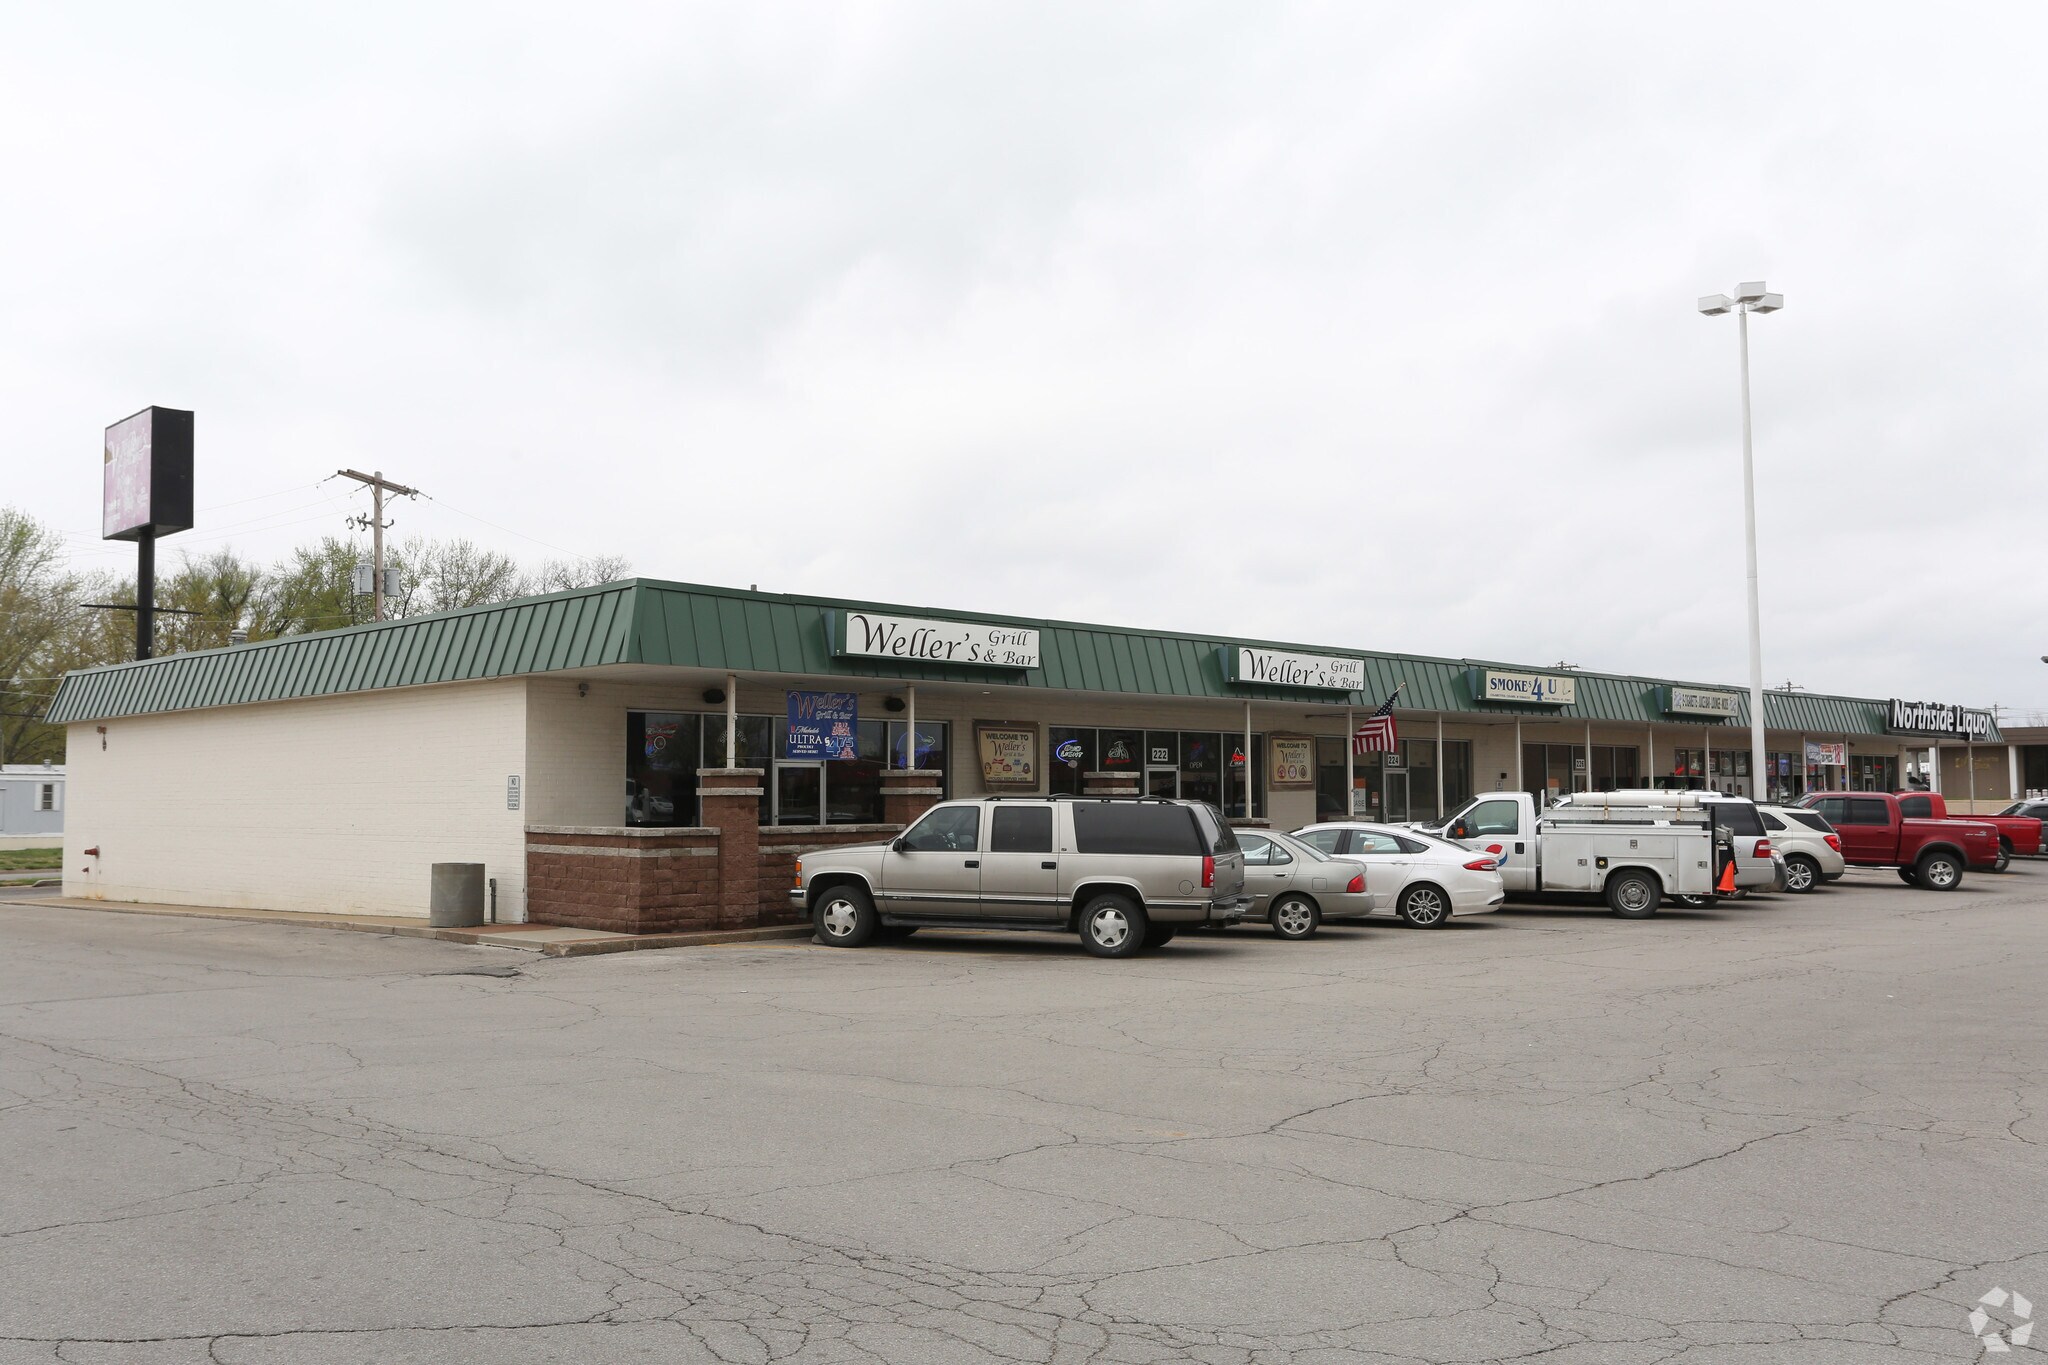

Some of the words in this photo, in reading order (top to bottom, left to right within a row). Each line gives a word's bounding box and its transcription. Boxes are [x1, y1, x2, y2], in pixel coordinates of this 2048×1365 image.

[850, 615, 980, 662] Weller's
[988, 630, 1031, 647] Grill
[983, 649, 996, 663] &
[1003, 651, 1036, 666] Bar
[1241, 649, 1326, 686] Weller's
[1330, 660, 1360, 674] Grill
[1327, 676, 1336, 687] &
[1340, 677, 1362, 689] Bar
[1531, 676, 1544, 701] 4
[1548, 678, 1557, 694] U
[788, 691, 855, 719] Weller's
[815, 710, 833, 720] Grill
[1893, 700, 1954, 732] Northside
[789, 734, 823, 745] ULTRA
[985, 732, 1018, 741] WELCOME
[991, 740, 1026, 756] Weller's
[1153, 749, 1167, 760] 222
[1189, 761, 1203, 769] OPEN
[1388, 756, 1399, 765] 224
